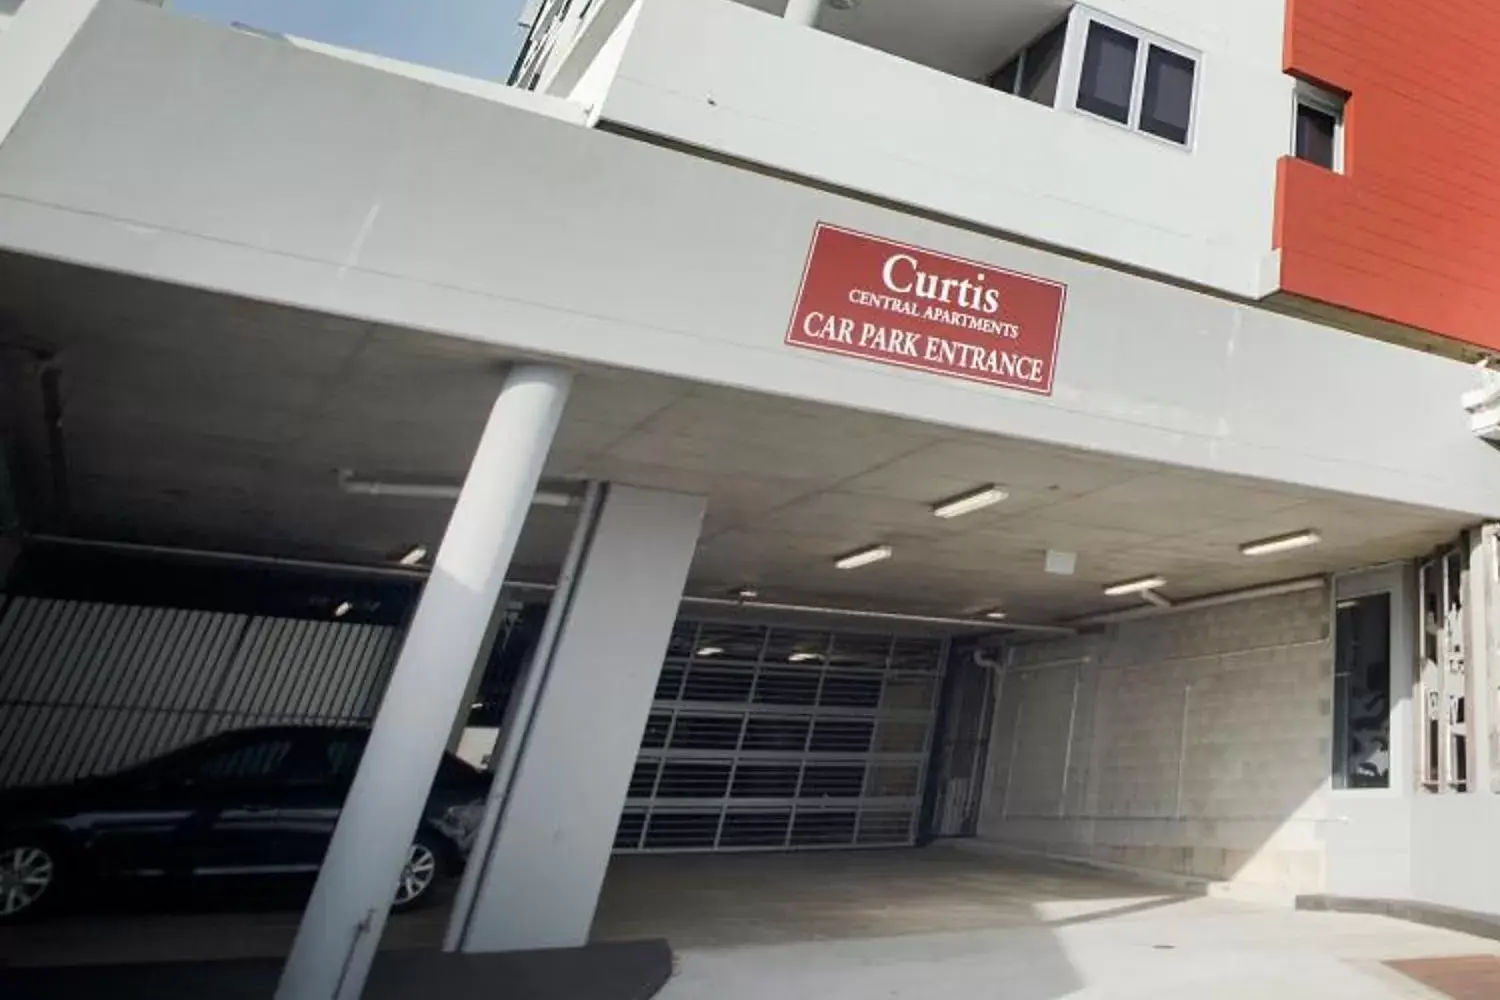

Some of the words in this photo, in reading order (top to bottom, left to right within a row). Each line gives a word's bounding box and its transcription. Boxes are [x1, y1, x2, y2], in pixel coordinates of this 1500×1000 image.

[848, 289, 920, 318] CENTRAL
[922, 305, 1019, 339] APARTMENTS
[881, 253, 1000, 314] Curtis
[803, 311, 854, 345] CAR
[859, 320, 921, 358] PARK
[924, 335, 1043, 383] ENTRANCE
